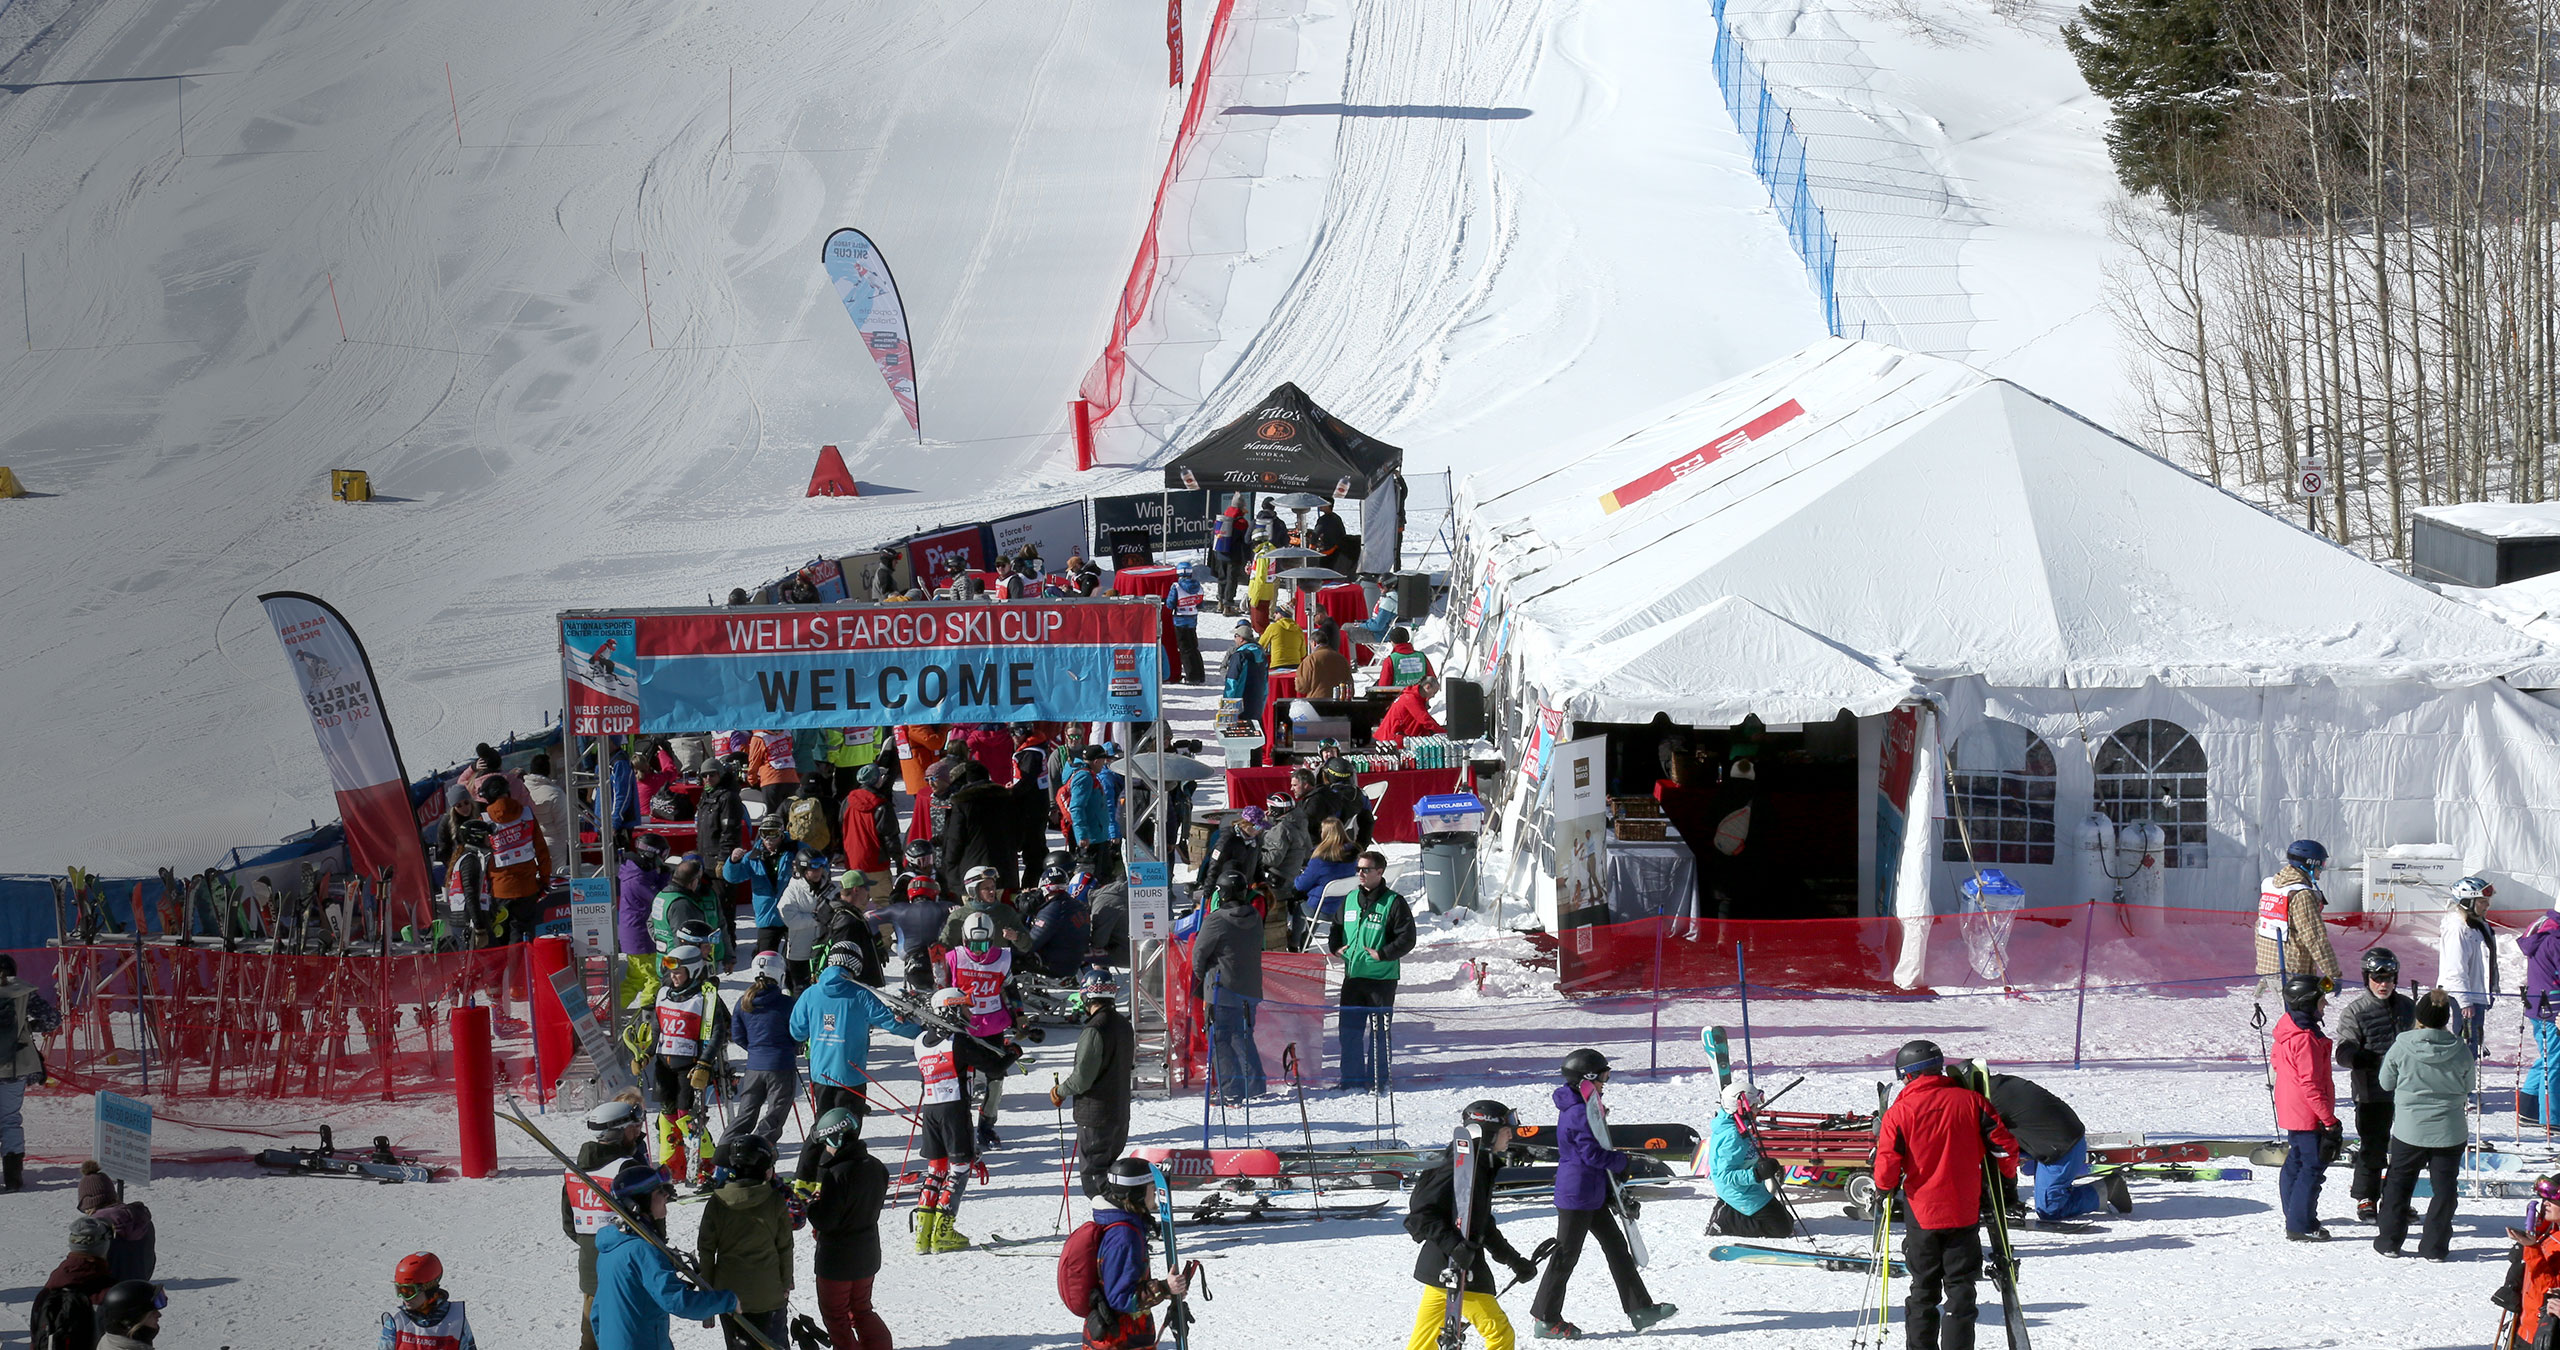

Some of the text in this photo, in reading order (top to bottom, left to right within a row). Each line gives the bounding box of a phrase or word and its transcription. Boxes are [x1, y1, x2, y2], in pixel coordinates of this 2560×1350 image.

[1257, 406, 1301, 421] Tito's
[1242, 440, 1302, 453] Handmade
[1223, 470, 1258, 483] Tito's
[1135, 501, 1175, 518] Win a
[1005, 527, 1022, 537] force
[1023, 524, 1033, 532] for
[1174, 515, 1214, 533] Picnic
[1007, 536, 1026, 546] better
[1117, 543, 1145, 554] Tito's
[566, 621, 632, 630] NATIONAL SPORTS
[725, 610, 1064, 652] WELLS FARGO SKI CUP
[566, 629, 633, 637] CENTER DISABLED
[757, 662, 1036, 712] WELCOME
[574, 704, 633, 715] WELLS FARGO
[575, 716, 634, 734] SKI CUP
[1427, 801, 1472, 810] RECYCLABLES
[493, 838, 506, 848] SKI
[506, 832, 522, 843] CUP
[585, 890, 609, 898] CORRAL
[1133, 889, 1163, 898] HOURS
[576, 905, 607, 915] HOURS
[970, 980, 997, 995] 244
[662, 1018, 686, 1035] 242
[105, 1104, 148, 1130] 50/50 RAFFLE
[577, 1187, 603, 1208] 142
[416, 1336, 437, 1346] FARGO
